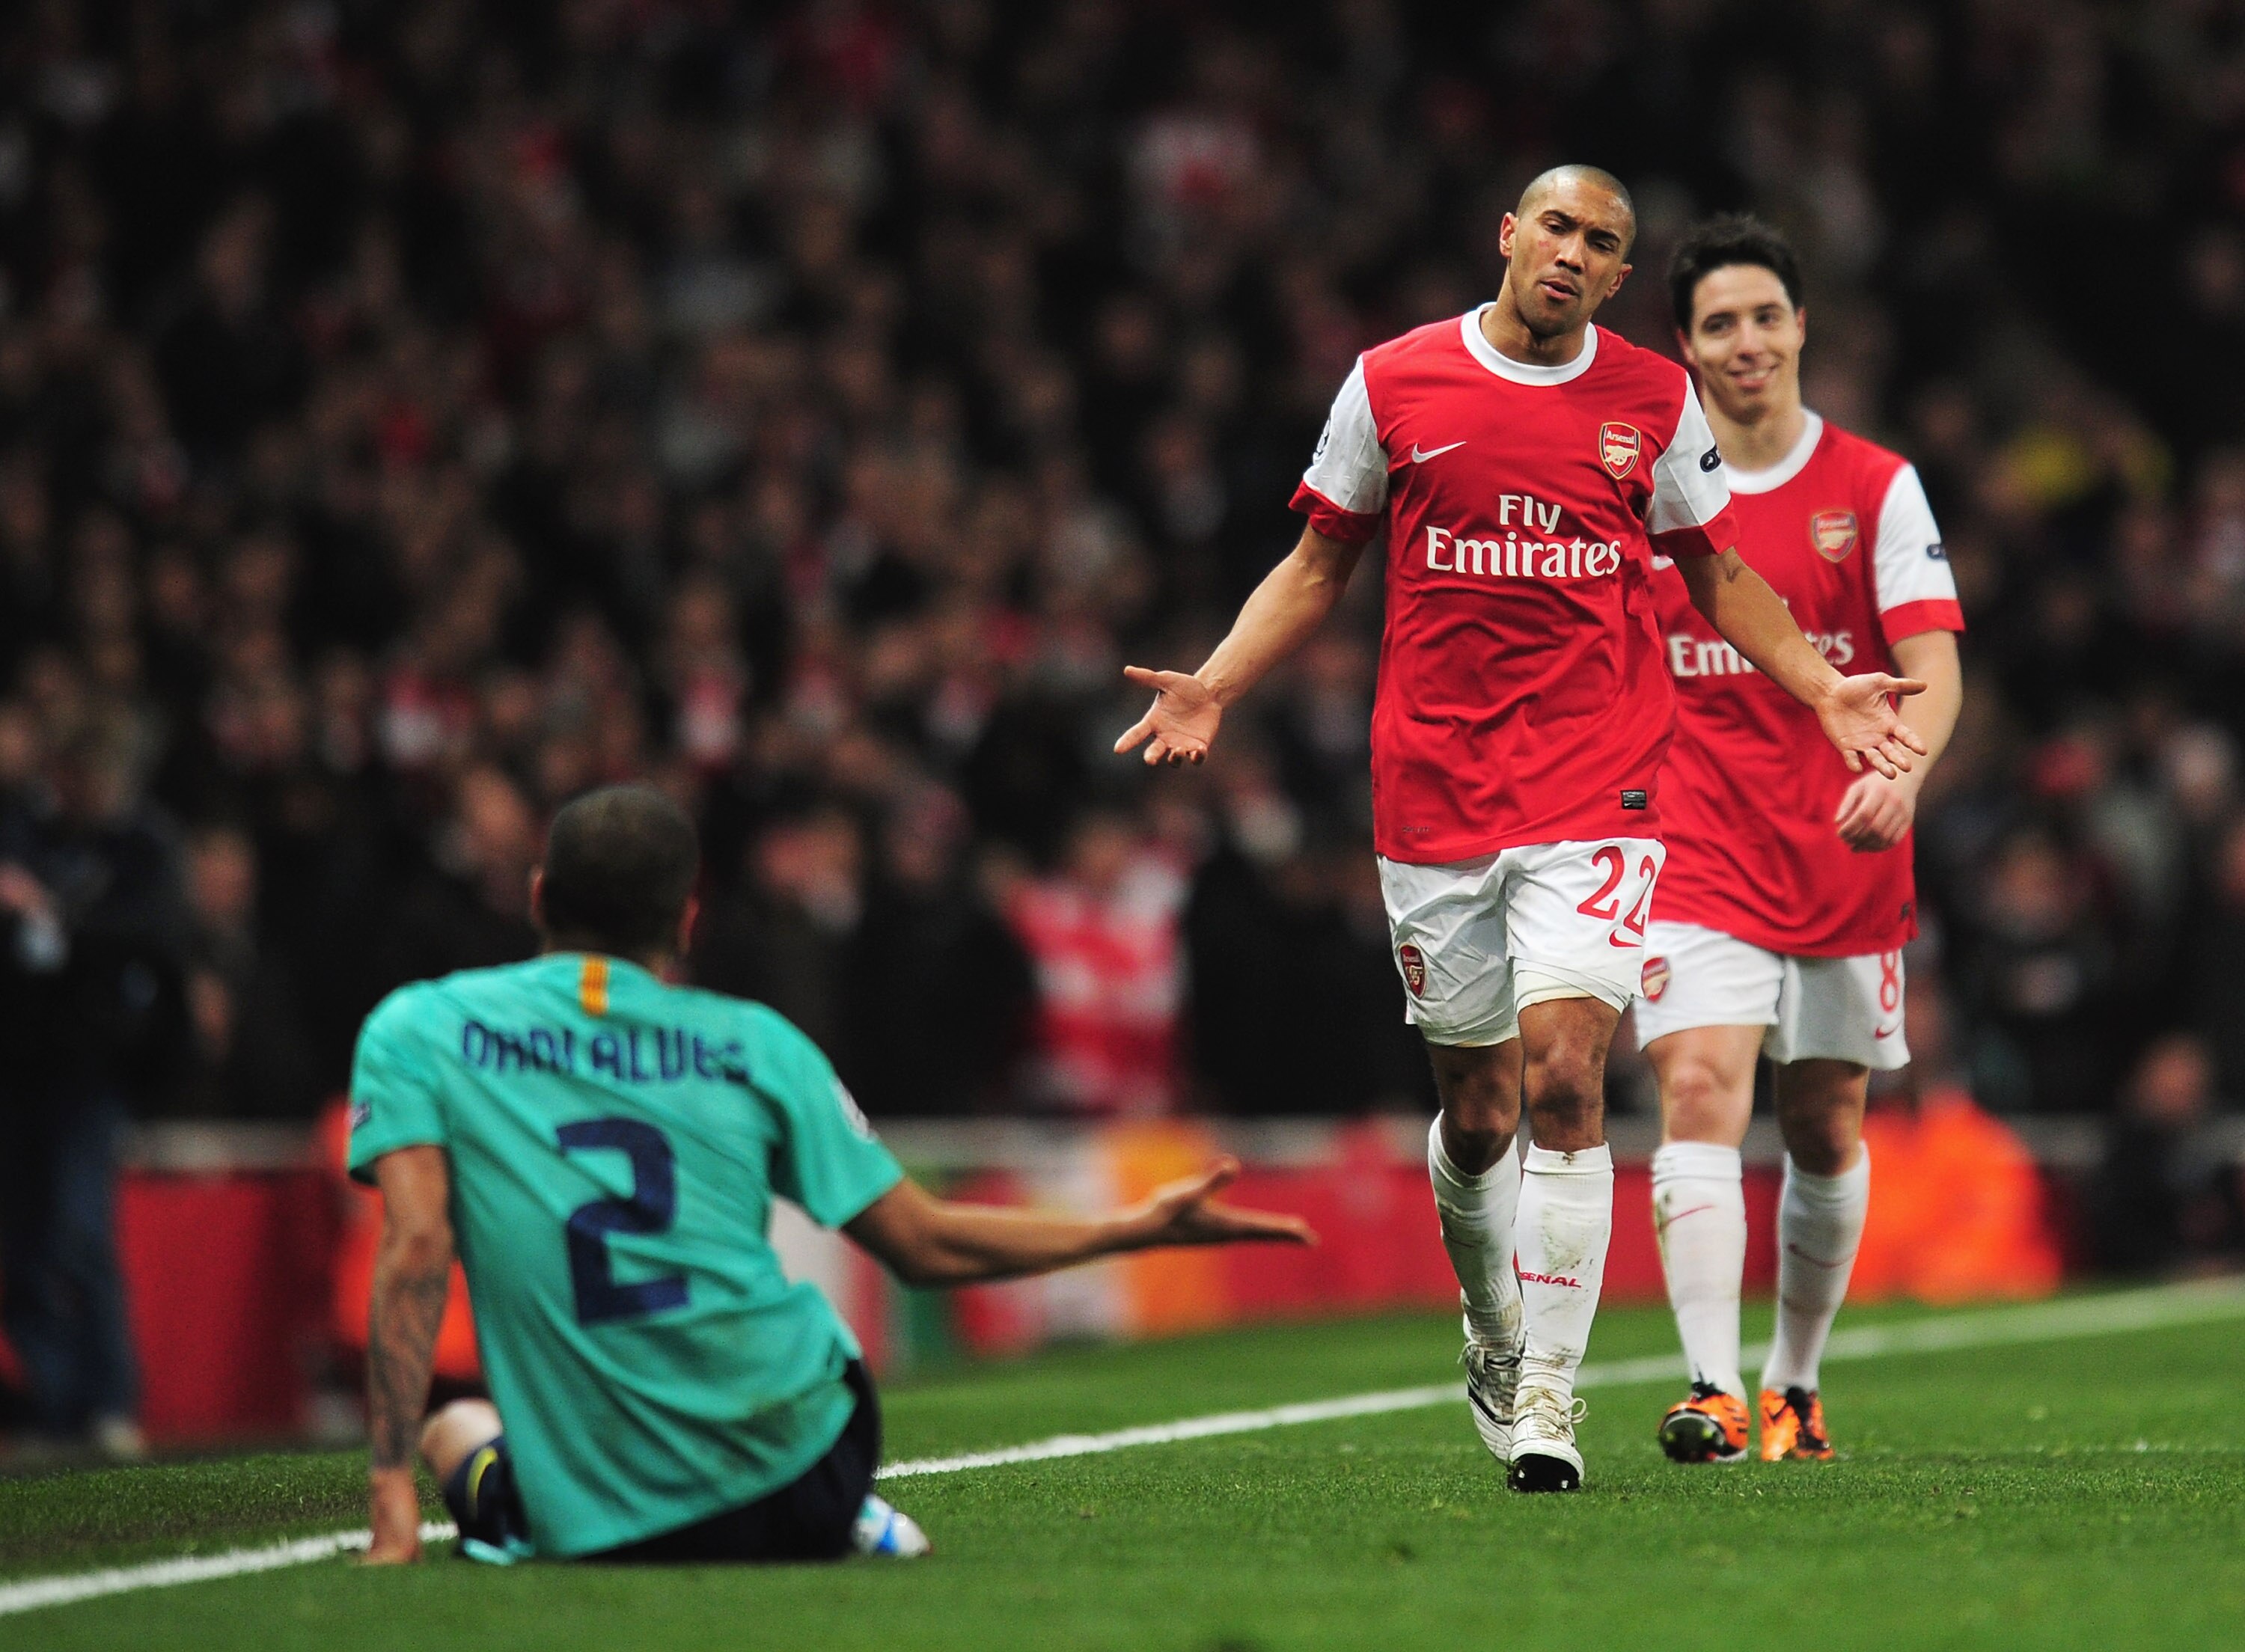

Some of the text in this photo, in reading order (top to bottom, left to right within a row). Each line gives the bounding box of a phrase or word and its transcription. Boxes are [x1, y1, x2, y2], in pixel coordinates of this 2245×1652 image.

[1499, 495, 1563, 534] Fly
[1426, 525, 1622, 578] Emirates
[1577, 845, 1656, 937] 22
[1880, 950, 1899, 1012] 8
[555, 1116, 691, 1328] 2
